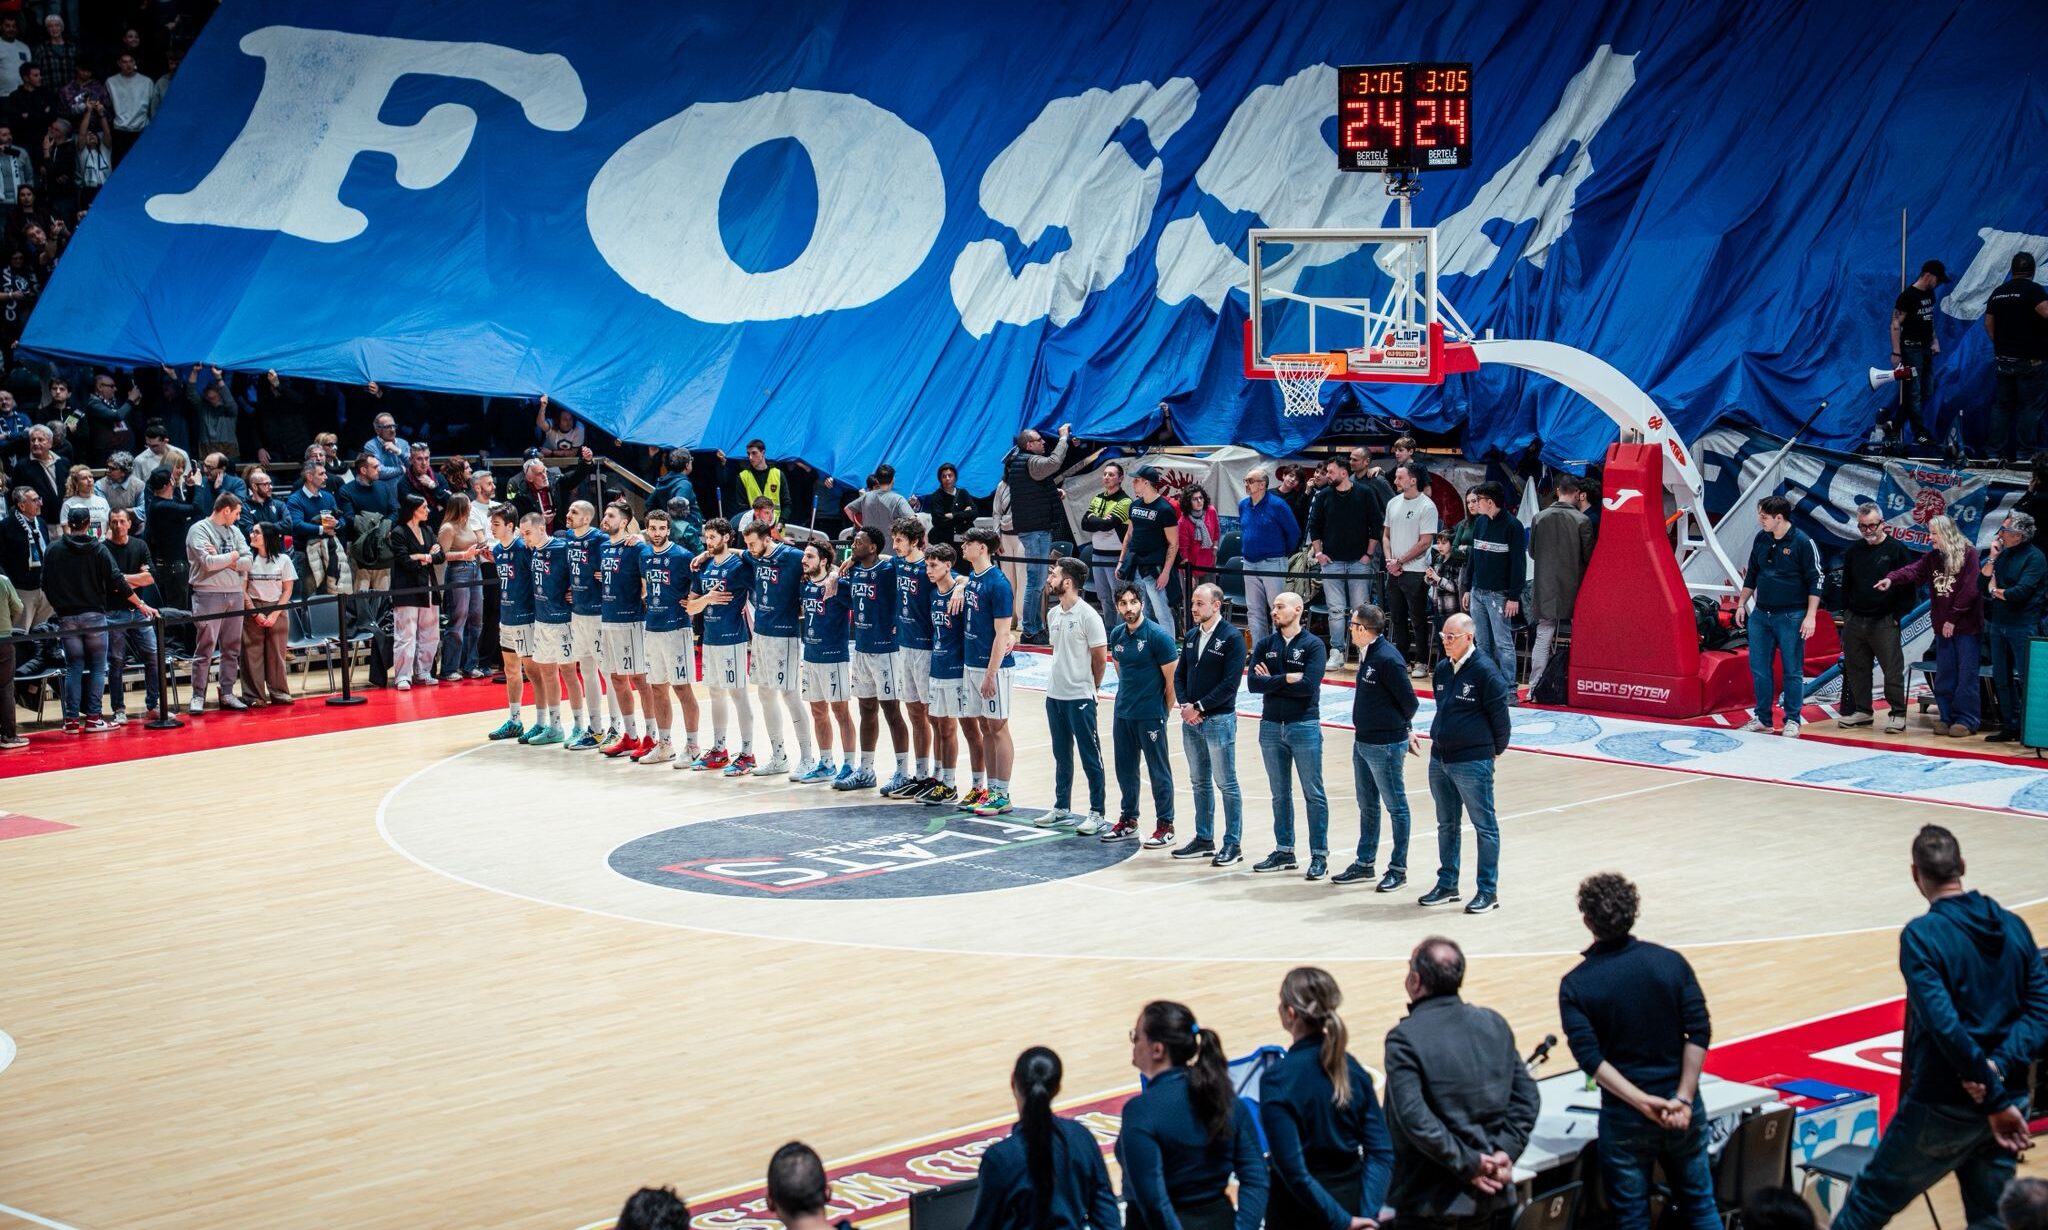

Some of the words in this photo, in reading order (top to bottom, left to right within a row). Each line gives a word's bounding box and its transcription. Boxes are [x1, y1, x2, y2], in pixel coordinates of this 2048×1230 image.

[1358, 71, 1403, 95] 3:05
[1426, 70, 1467, 92] 3:05
[1347, 101, 1400, 147] 24
[1416, 99, 1465, 146] 24
[1396, 331, 1419, 341] LNP
[1887, 493, 1905, 511] 19
[1954, 504, 1977, 523] 70
[567, 548, 587, 563] FLATS
[571, 562, 581, 576] 26
[755, 567, 778, 582] FLATS
[501, 577, 508, 590] 77
[534, 572, 543, 586] 31
[604, 571, 612, 585] 21
[646, 570, 669, 584] FLATS
[896, 576, 917, 593] FLATS
[652, 583, 661, 596] 14
[762, 580, 768, 594] 9
[851, 583, 875, 598] FLATS
[802, 599, 825, 613] FLATS
[859, 597, 865, 612] 6
[903, 591, 908, 606] 3
[808, 612, 815, 626] 7
[931, 612, 951, 627] FLATS
[936, 625, 940, 640] 1
[594, 639, 601, 653] 2
[622, 656, 633, 670] 21
[675, 665, 688, 680] 14
[724, 669, 736, 684] 10
[777, 671, 785, 686] 9
[831, 683, 837, 697] 7
[883, 680, 891, 695] 6
[988, 699, 997, 713] 0
[703, 816, 1062, 887] FLATS
[788, 832, 925, 860] SERVICE
